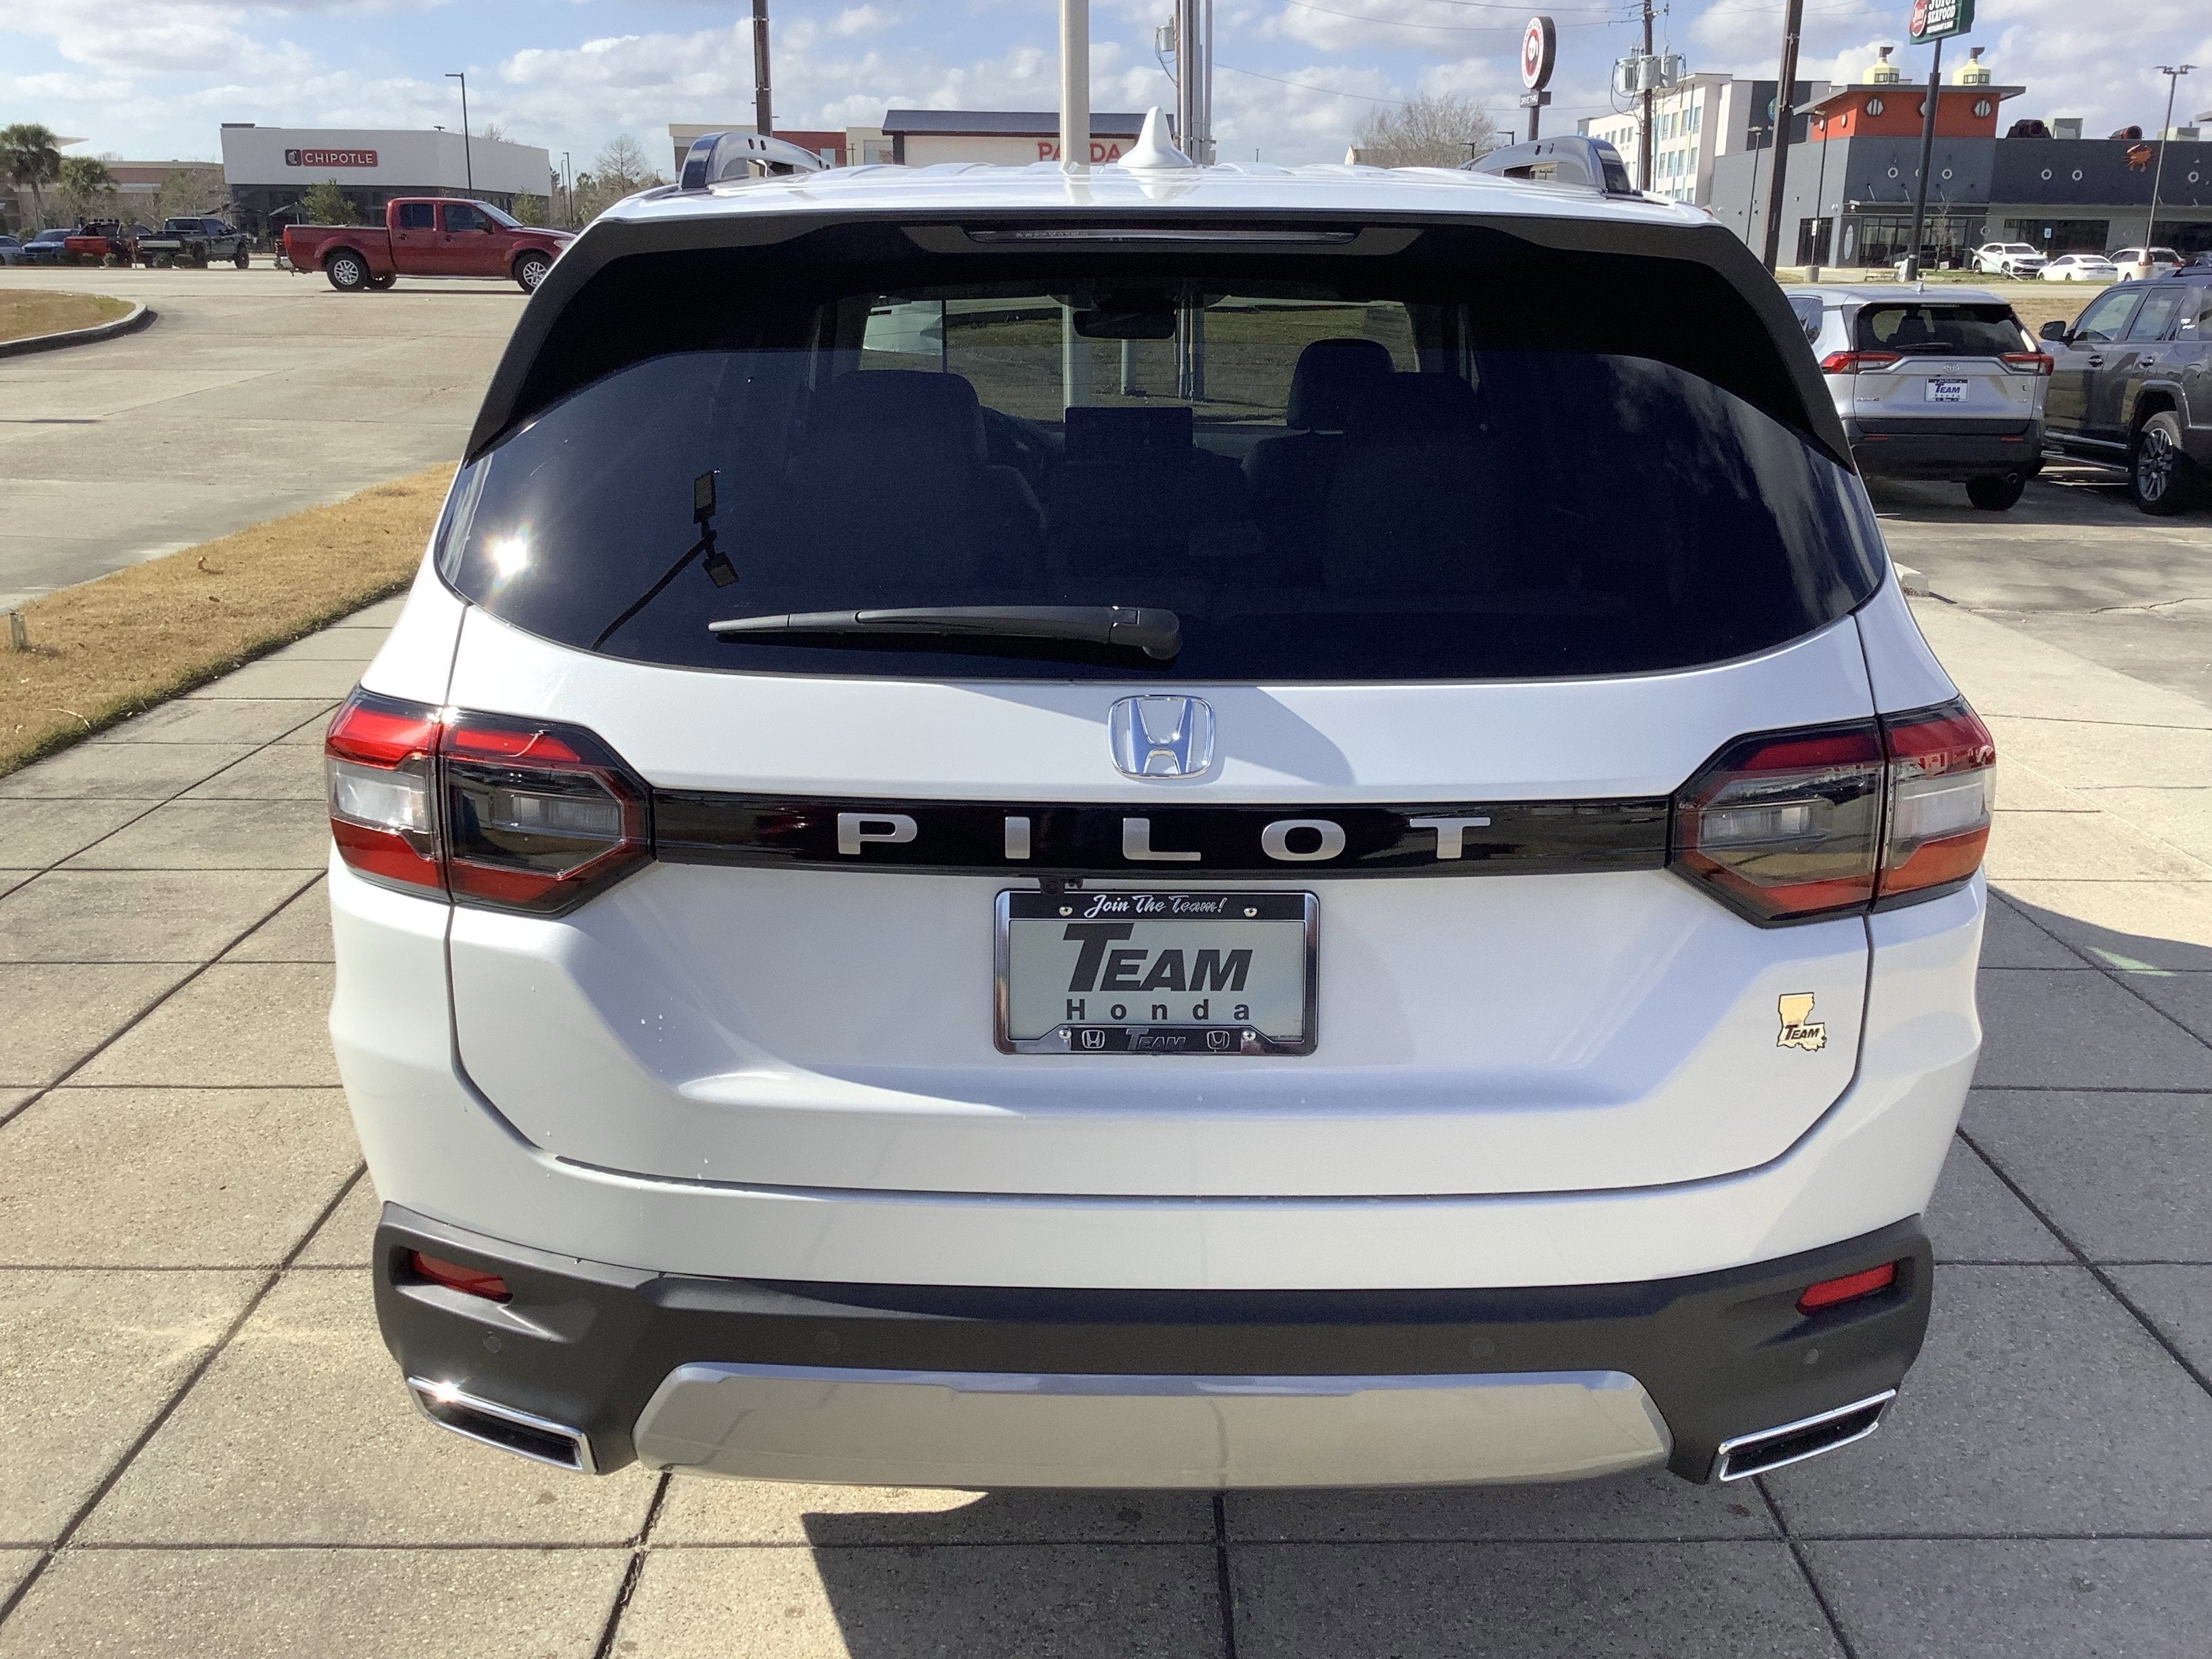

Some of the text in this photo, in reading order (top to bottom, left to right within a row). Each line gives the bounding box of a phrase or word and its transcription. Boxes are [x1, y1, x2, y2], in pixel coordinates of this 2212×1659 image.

[1927, 5, 1956, 24] SEAFOOD
[1929, 0, 1955, 10] JUI
[304, 152, 373, 164] CHIPOTLE
[1038, 142, 1121, 163] PDA
[1936, 384, 1960, 393] TEAM
[837, 812, 1491, 861] PILOT
[1084, 894, 1228, 918] Join The Team!
[1062, 922, 1254, 992] TEAM
[1066, 998, 1250, 1021] Honda
[1125, 1028, 1187, 1050] TEAM
[1784, 1025, 1820, 1040] TEAM
